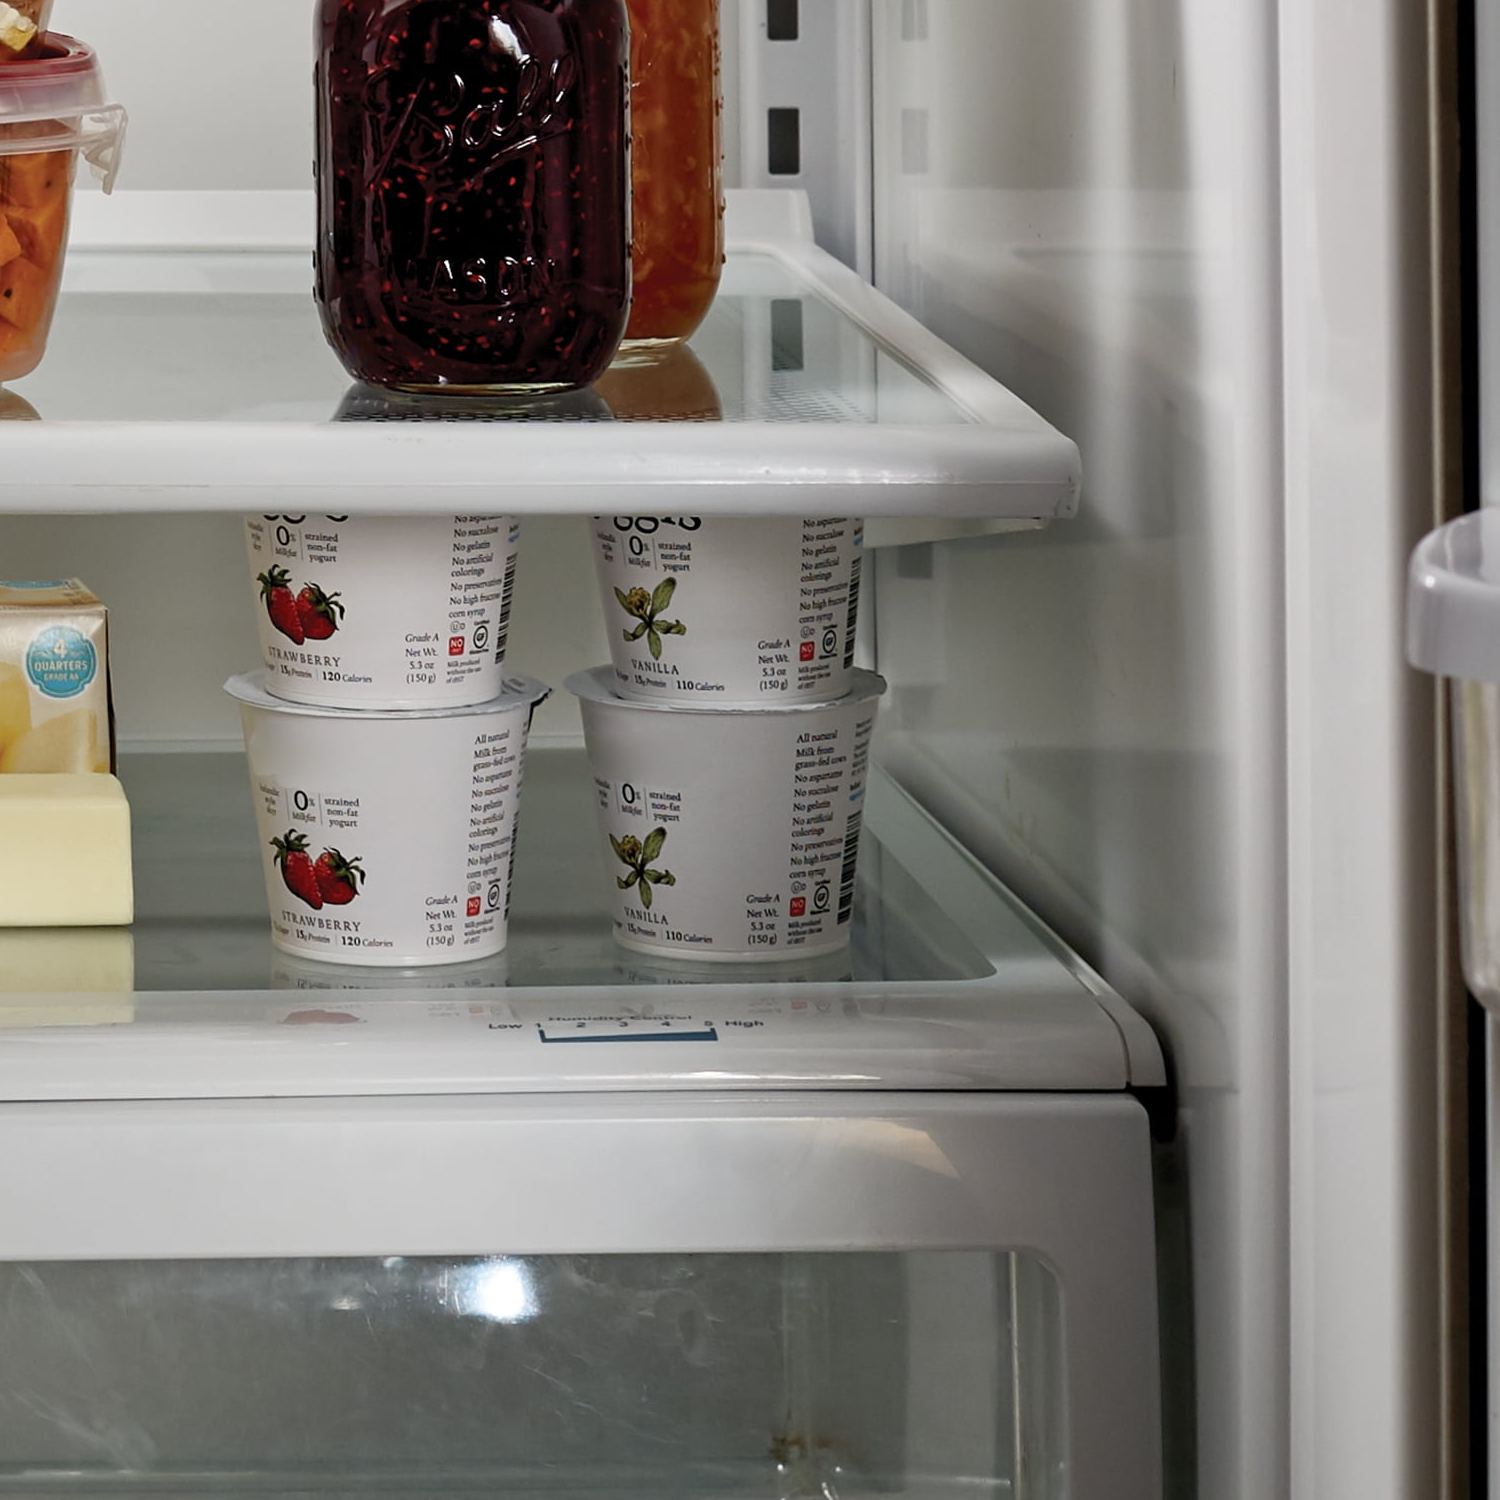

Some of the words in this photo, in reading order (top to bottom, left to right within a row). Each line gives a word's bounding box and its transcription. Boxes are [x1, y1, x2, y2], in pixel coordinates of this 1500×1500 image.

[304, 533, 339, 543] strained
[307, 543, 338, 552] non-fat
[658, 542, 692, 551] strained
[309, 553, 337, 563] yogurt
[660, 552, 691, 561] non-fat
[662, 563, 691, 572] yogurt
[405, 633, 431, 643] Grade
[431, 632, 440, 642] A
[53, 638, 68, 658] 4
[405, 648, 422, 657] Net
[268, 645, 341, 668] STRAWBERRY
[34, 660, 88, 671] QUARTERS
[409, 661, 423, 670] 5.3
[424, 662, 435, 670] oz
[631, 658, 680, 676] VANILLA
[43, 673, 68, 681] GRADE
[322, 671, 341, 682] 120
[342, 672, 373, 683] Calories
[676, 680, 694, 690] 110
[695, 682, 725, 692] Calories
[324, 797, 360, 807] strained
[649, 792, 682, 802] strained
[651, 802, 681, 812] non-fat
[327, 808, 359, 817] non-fat
[329, 818, 358, 828] yogurt
[653, 813, 681, 823] yogurt
[623, 905, 669, 926] VANILLA
[282, 910, 362, 932] STRAWBERRY
[341, 936, 361, 947] 120
[362, 938, 394, 948] Calories
[665, 930, 683, 941] 110
[683, 933, 714, 944] Calories
[548, 1015, 623, 1023] Humidity
[725, 1019, 765, 1028] High
